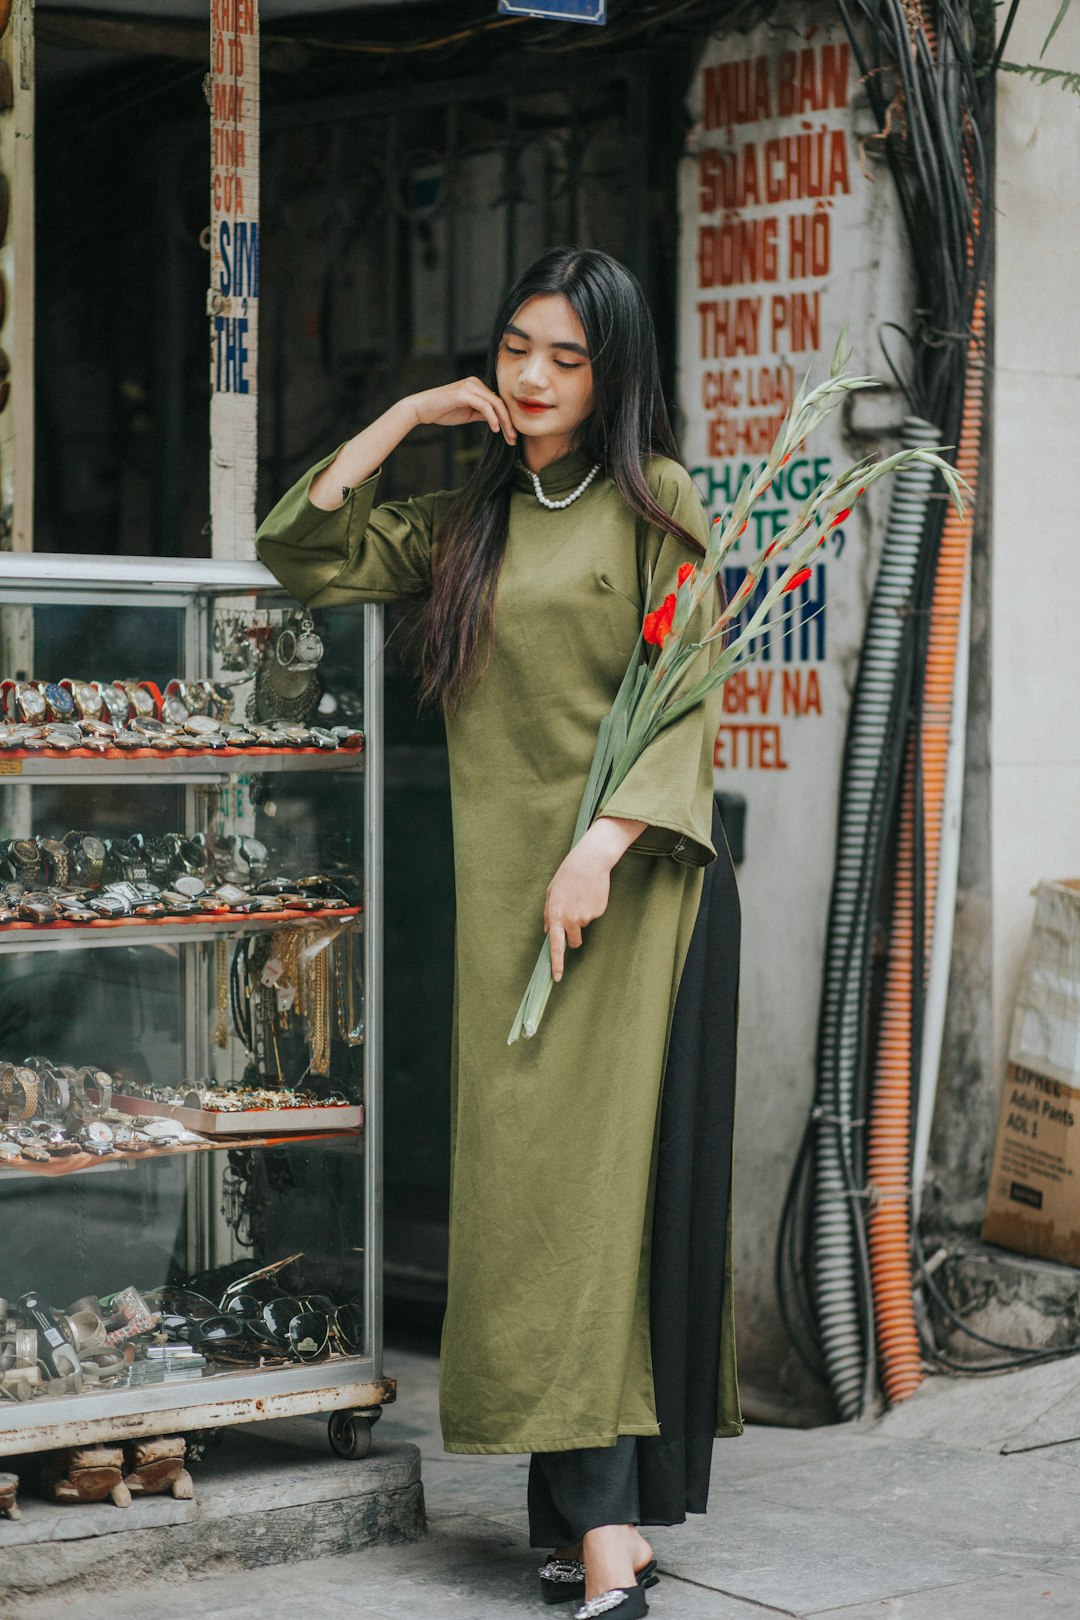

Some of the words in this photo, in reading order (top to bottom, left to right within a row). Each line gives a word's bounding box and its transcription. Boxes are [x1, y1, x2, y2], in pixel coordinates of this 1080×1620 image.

[703, 55, 772, 131] MUA
[777, 25, 851, 118] BÁN
[219, 220, 259, 298] SIM
[697, 298, 760, 359] THAY
[771, 291, 822, 353] PIN
[713, 723, 788, 770] ETTEL
[1042, 1100, 1075, 1127] Pants
